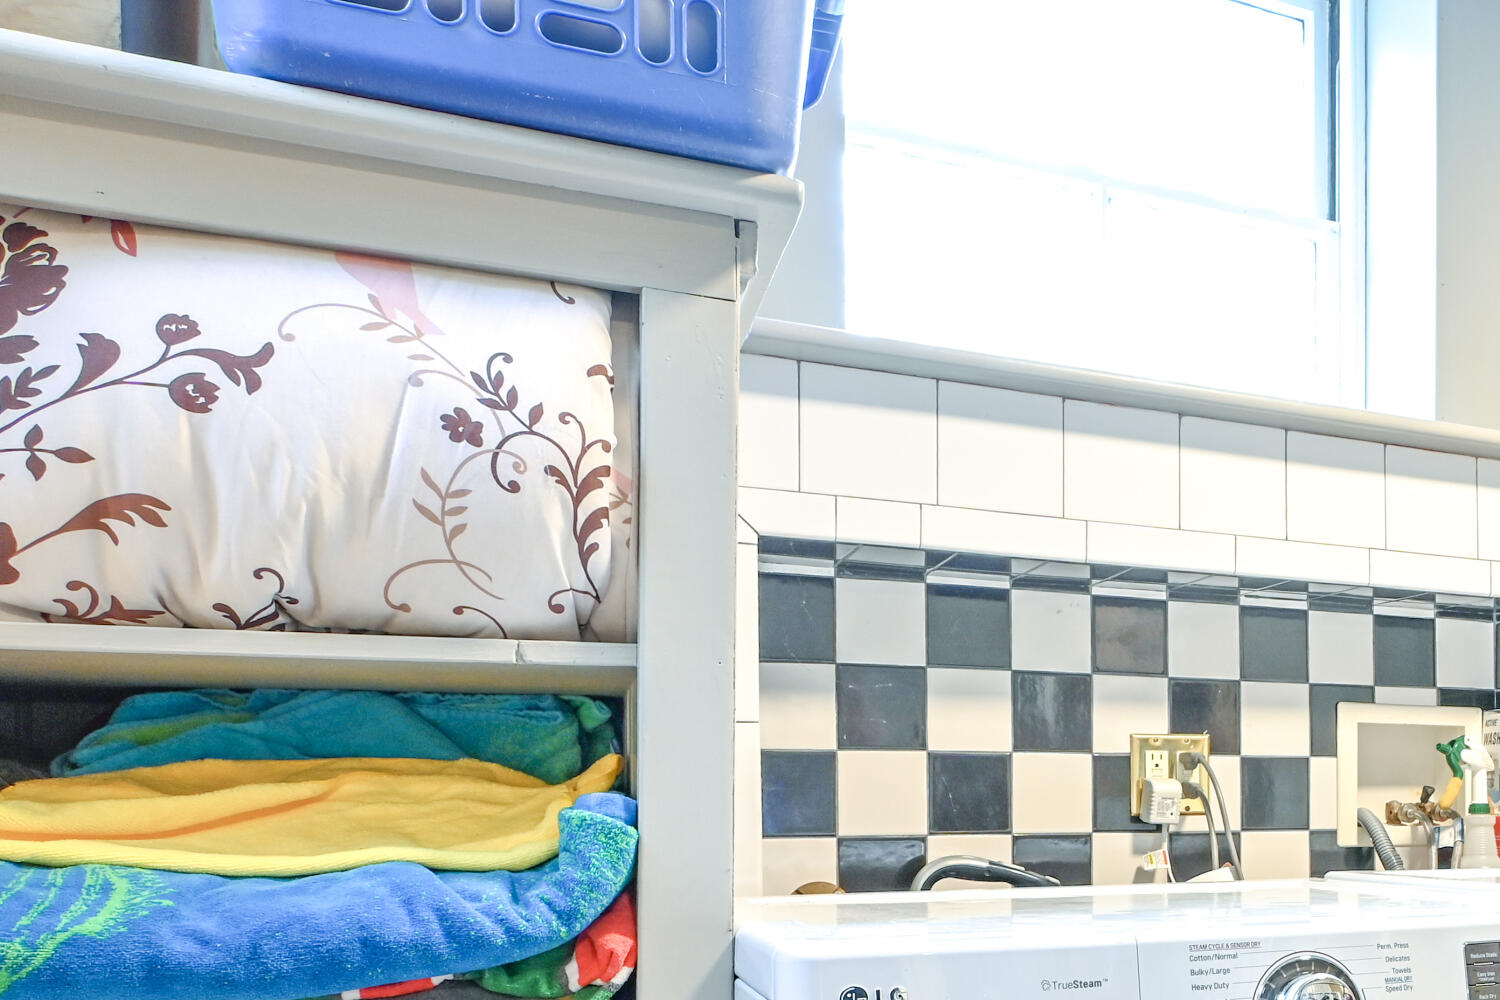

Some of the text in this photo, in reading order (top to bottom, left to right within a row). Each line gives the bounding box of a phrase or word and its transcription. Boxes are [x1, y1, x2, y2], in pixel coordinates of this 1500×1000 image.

[1189, 952, 1238, 962] Cotton/Normal
[1385, 955, 1411, 963] Delicates
[1190, 967, 1231, 977] Bulky/Large
[1191, 982, 1230, 992] Heavy Duty
[1385, 984, 1413, 993] Speed Dry
